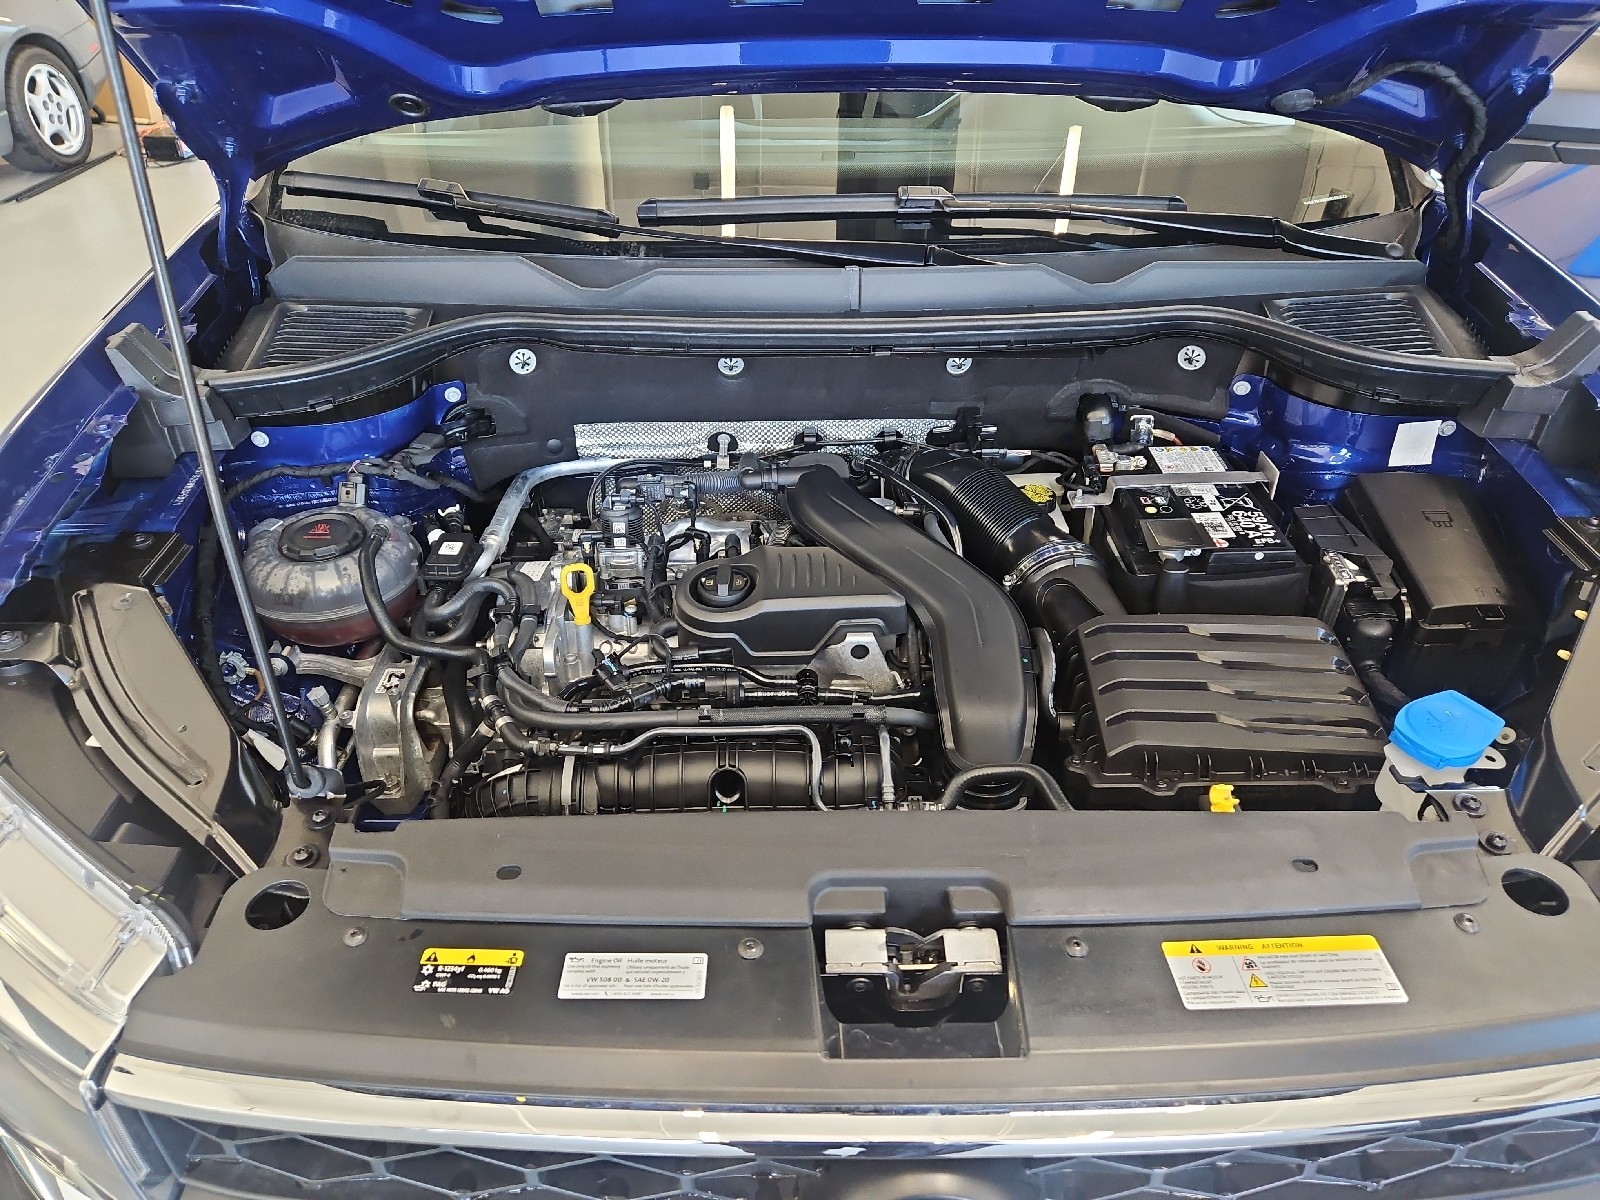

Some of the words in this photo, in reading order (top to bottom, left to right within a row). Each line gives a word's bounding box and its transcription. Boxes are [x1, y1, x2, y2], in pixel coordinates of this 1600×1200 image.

[1231, 511, 1256, 529] 640
[1247, 529, 1264, 539] A
[1248, 511, 1277, 537] 59Ah
